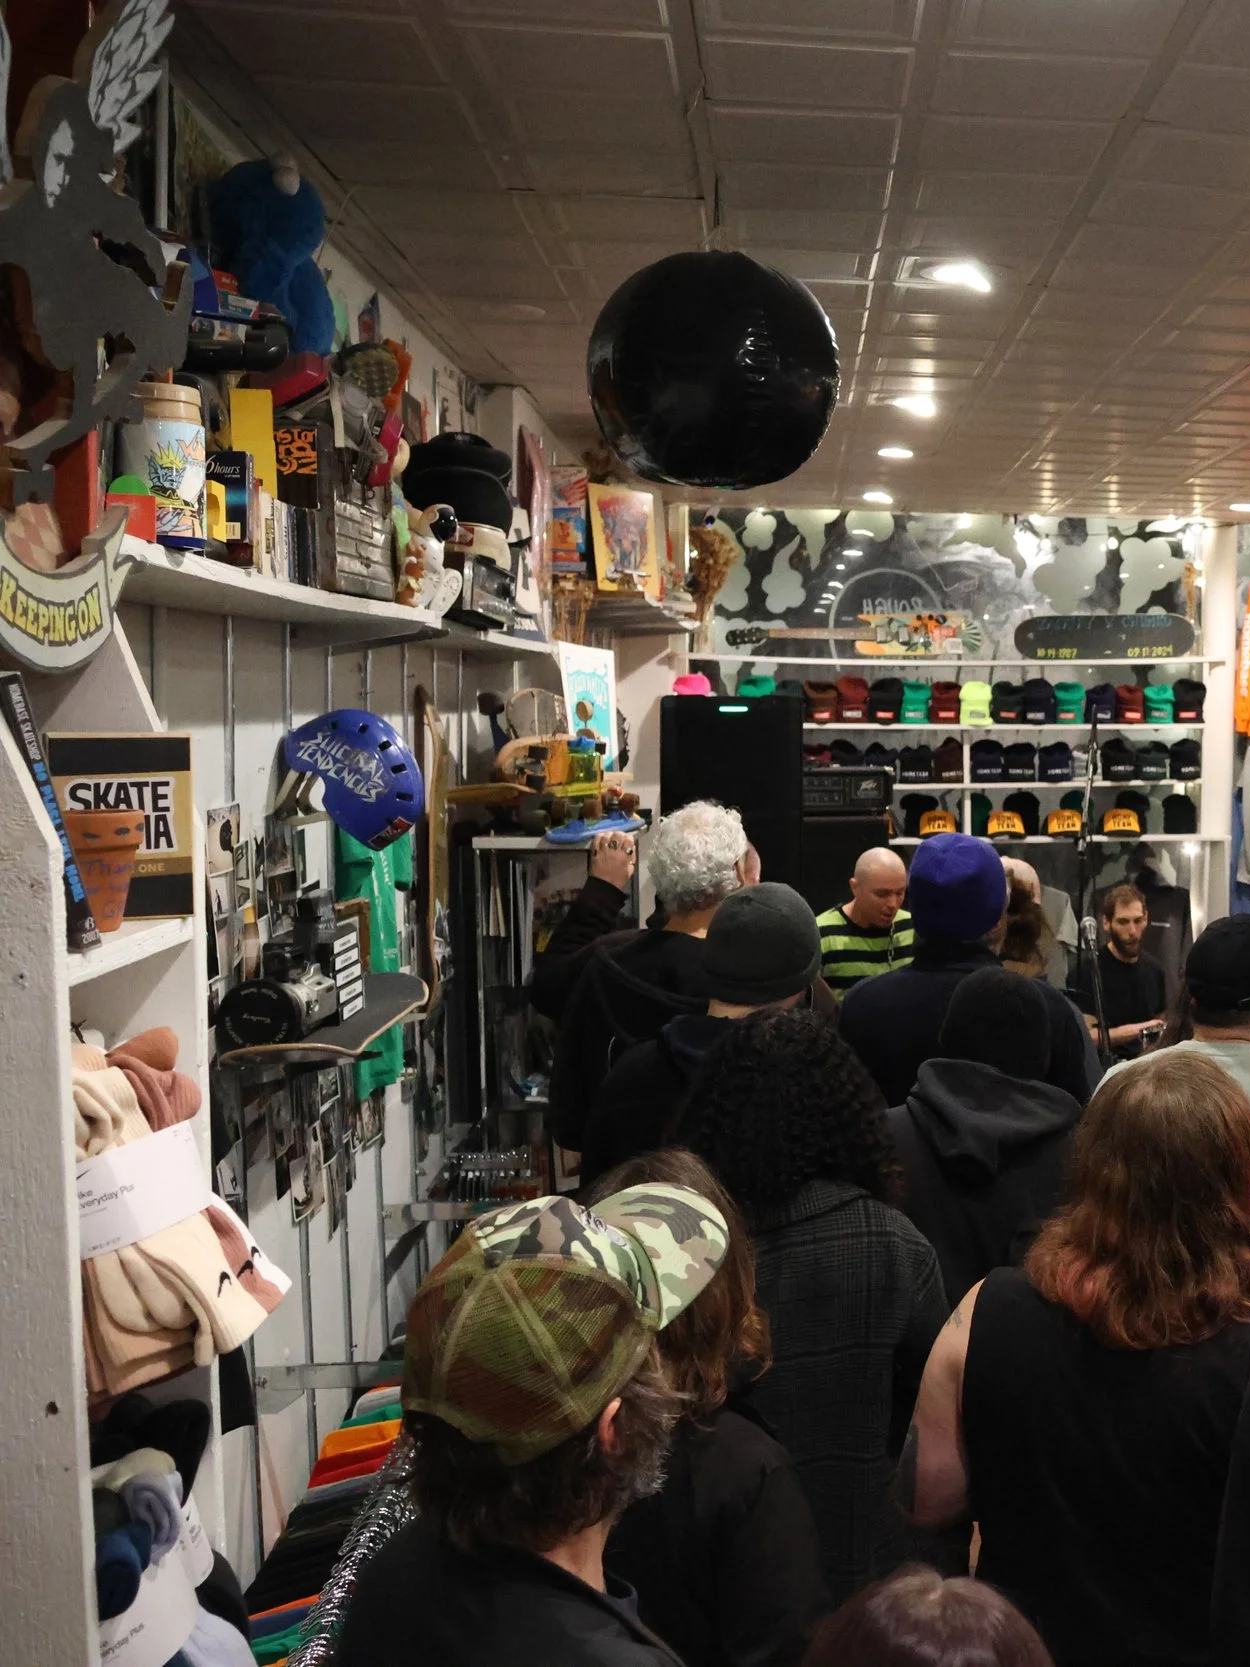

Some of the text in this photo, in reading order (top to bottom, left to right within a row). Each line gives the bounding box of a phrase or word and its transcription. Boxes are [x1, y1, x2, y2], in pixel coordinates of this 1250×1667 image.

[214, 462, 241, 474] hours
[1, 566, 104, 646] KEEPING ON
[20, 720, 42, 761] SKATESHOP
[32, 762, 49, 782] NO
[69, 781, 171, 811] SKATE
[138, 862, 165, 874] ONE
[79, 1190, 119, 1209] veryday
